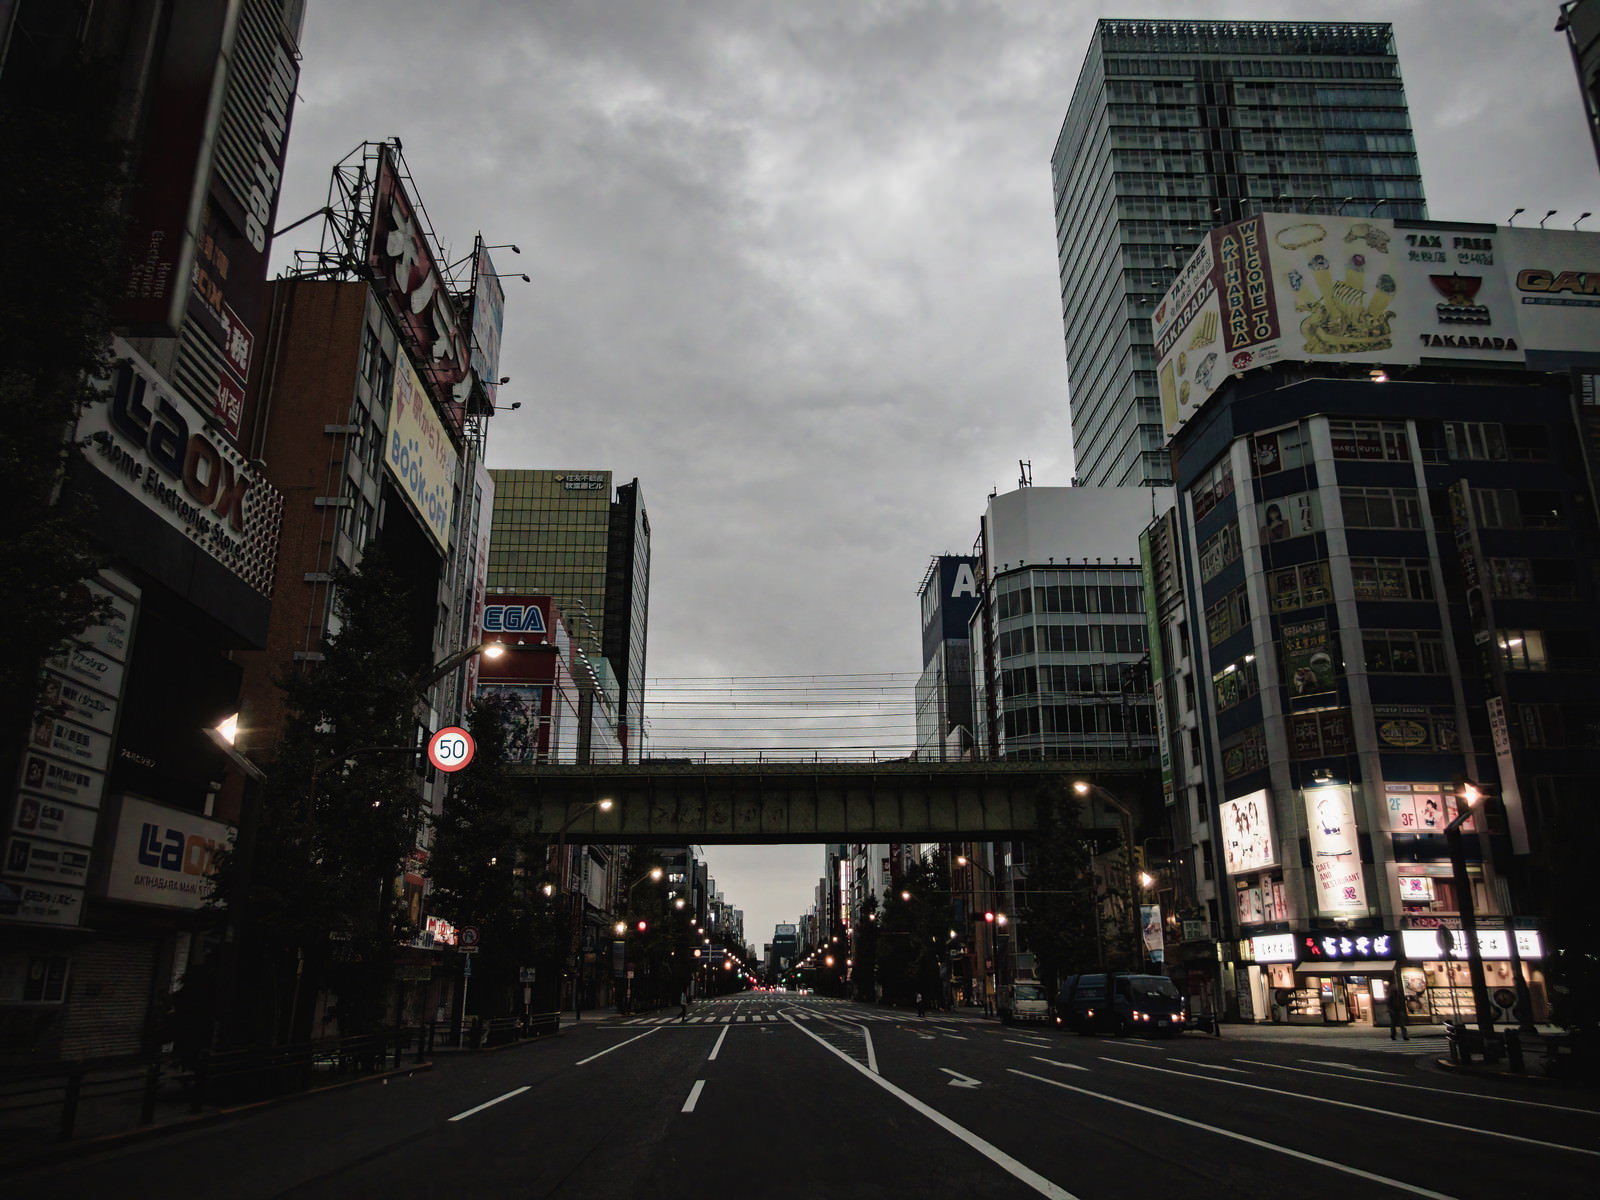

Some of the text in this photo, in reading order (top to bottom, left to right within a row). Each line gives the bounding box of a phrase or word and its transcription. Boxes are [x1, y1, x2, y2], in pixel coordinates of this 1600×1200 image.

[245, 142, 281, 254] Free
[1406, 235, 1493, 250] TAX FREE
[1222, 236, 1249, 347] AKIHABARA
[1238, 220, 1266, 307] WELCOME
[1254, 312, 1271, 339] TO
[1159, 278, 1215, 355] TAKARADA
[1420, 333, 1518, 351] TAKARADA
[143, 465, 210, 537] Electronics
[211, 524, 242, 557] Store
[482, 605, 547, 633] EGA
[439, 740, 465, 759] 50
[1390, 797, 1401, 811] 2F
[1401, 813, 1414, 826] 3F
